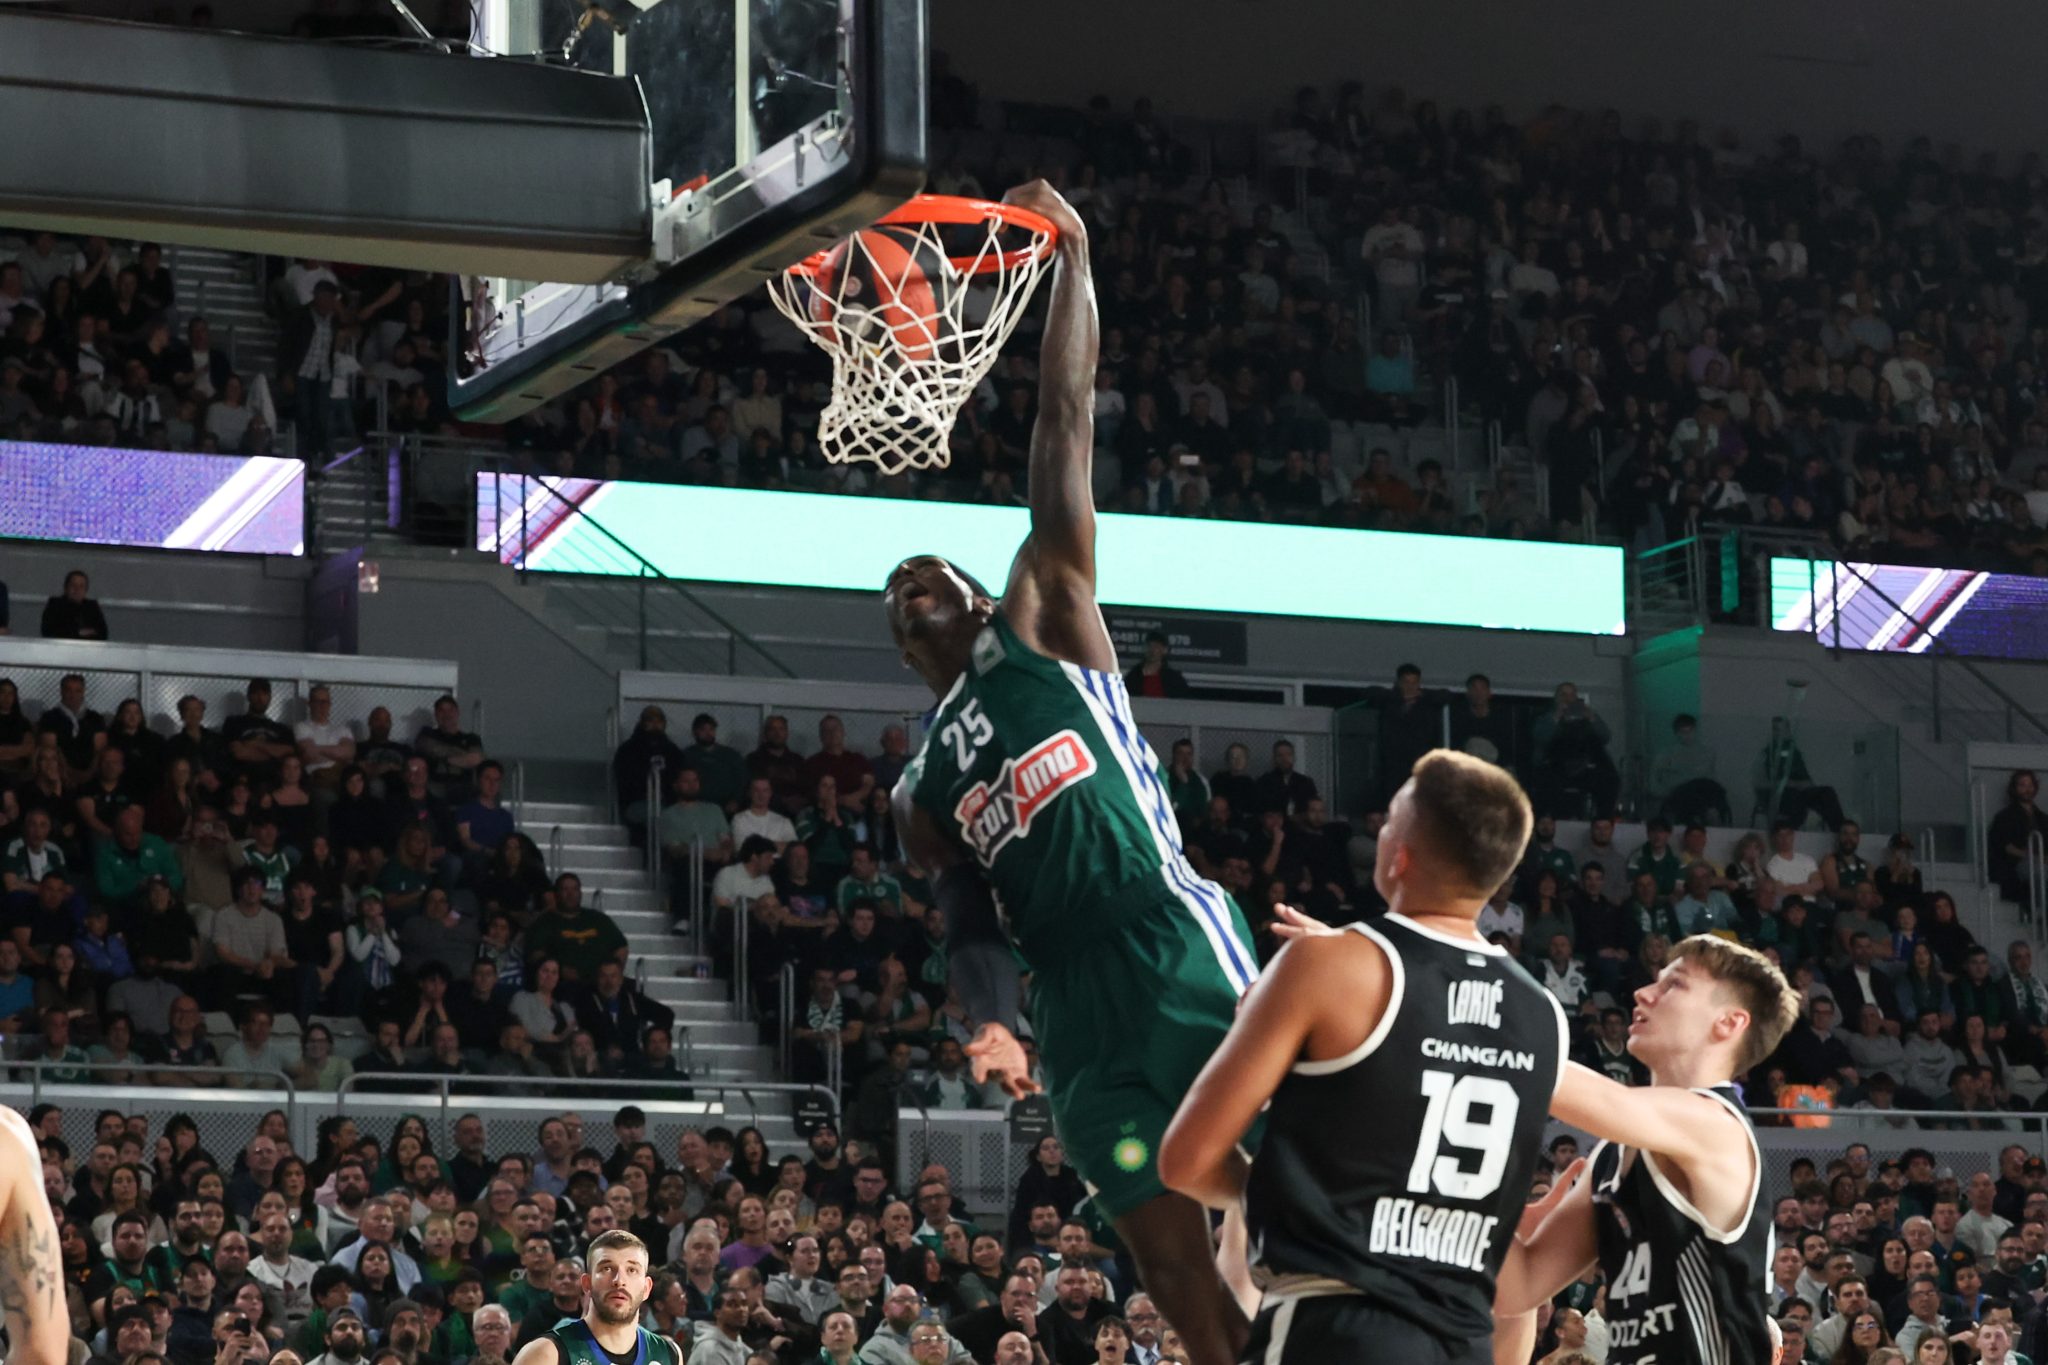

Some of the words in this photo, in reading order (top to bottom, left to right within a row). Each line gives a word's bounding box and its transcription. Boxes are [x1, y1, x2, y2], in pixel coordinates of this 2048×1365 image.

[941, 697, 994, 772] 25
[1448, 979, 1504, 1030] LAKIĆ
[1421, 1037, 1535, 1072] CHANGAN
[1407, 1069, 1520, 1200] 19
[1369, 1197, 1498, 1273] BELGRADE
